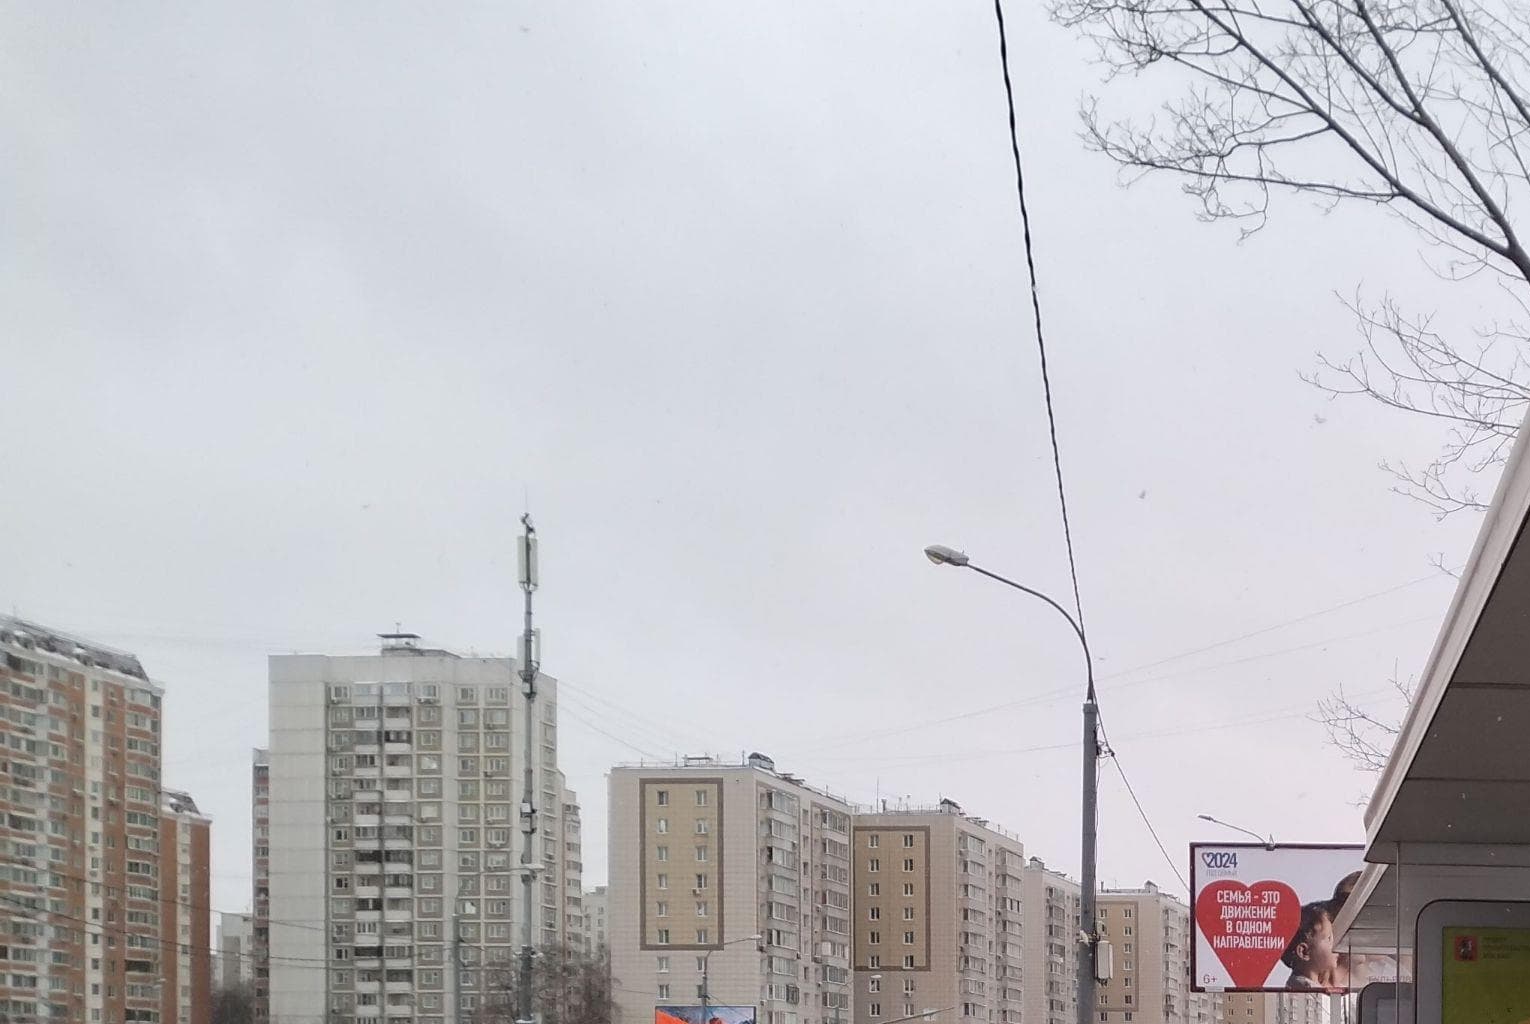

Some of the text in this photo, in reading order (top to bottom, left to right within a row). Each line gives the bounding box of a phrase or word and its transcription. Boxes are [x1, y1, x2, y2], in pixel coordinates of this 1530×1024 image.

[1206, 852, 1238, 868] 2024
[1217, 890, 1251, 903] СЕМЬЯ
[1262, 890, 1280, 903] ЭТО
[1220, 906, 1277, 920] ДВИЖЕНИЕ
[1226, 921, 1272, 935] В ОДНОМ
[1213, 936, 1285, 949] НАПРАВЛЕНИИ
[1203, 973, 1218, 984] 6+
